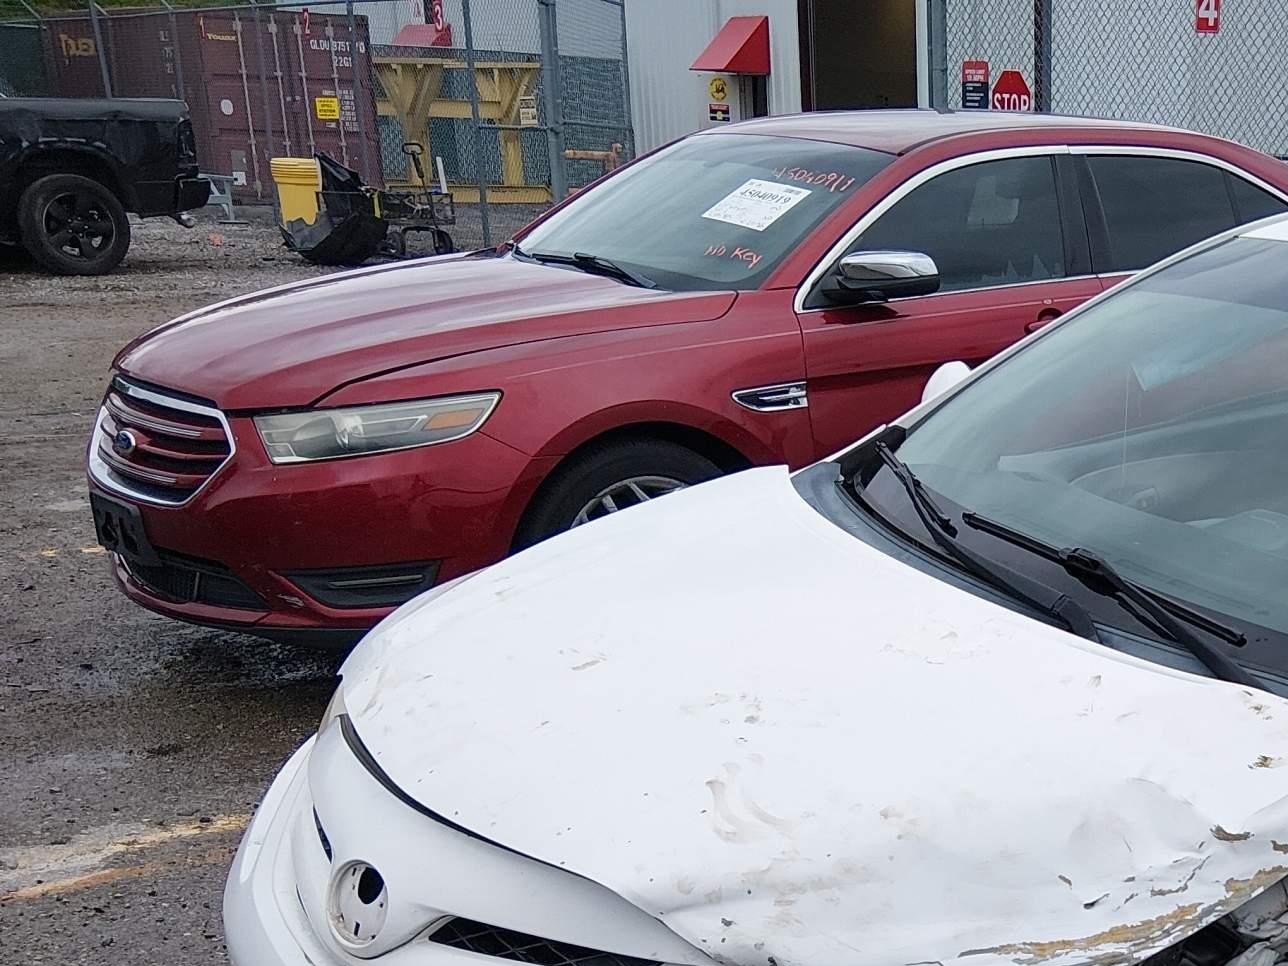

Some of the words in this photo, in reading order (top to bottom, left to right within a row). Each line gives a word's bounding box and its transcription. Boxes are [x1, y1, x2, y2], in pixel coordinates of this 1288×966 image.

[303, 12, 311, 34] 2
[434, 4, 443, 31] 3
[1198, 0, 1218, 27] 4
[993, 93, 1030, 111] STOP
